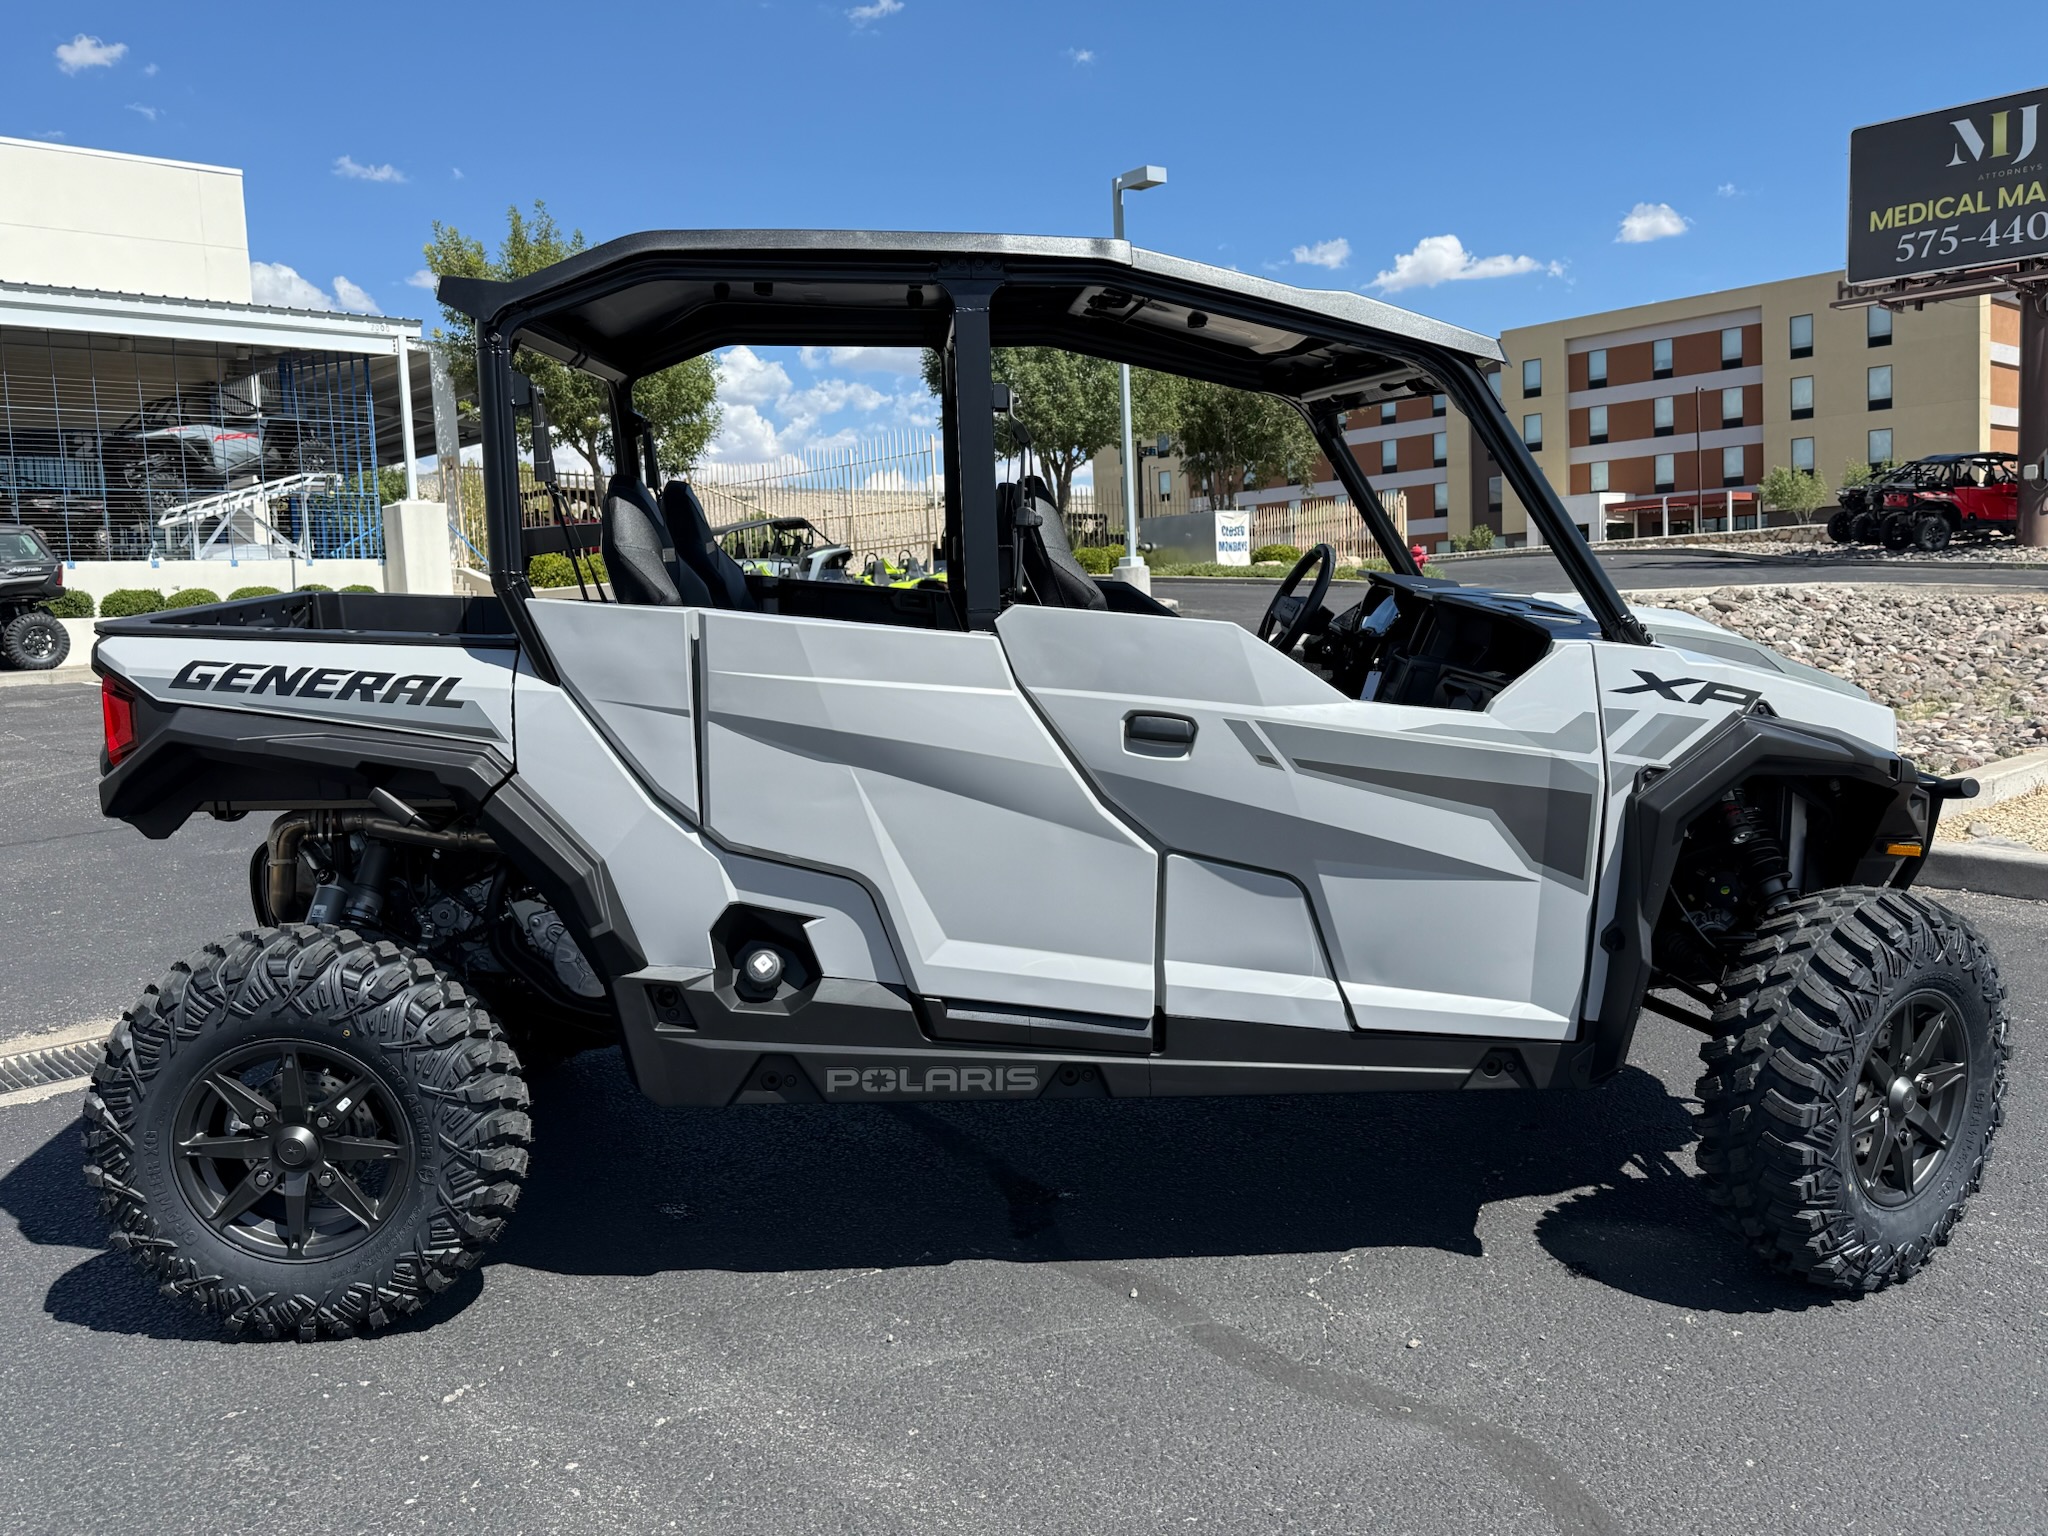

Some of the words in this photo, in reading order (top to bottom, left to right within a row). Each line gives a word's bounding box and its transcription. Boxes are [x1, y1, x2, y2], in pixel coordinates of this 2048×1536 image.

[1978, 163, 2043, 181] ATTORNEYS
[1869, 190, 1990, 233] MEDICAL
[168, 660, 465, 709] GENERAL
[826, 1067, 1039, 1093] POLARIS
[143, 1130, 159, 1157] XG
[146, 1160, 200, 1246] CRAWLER
